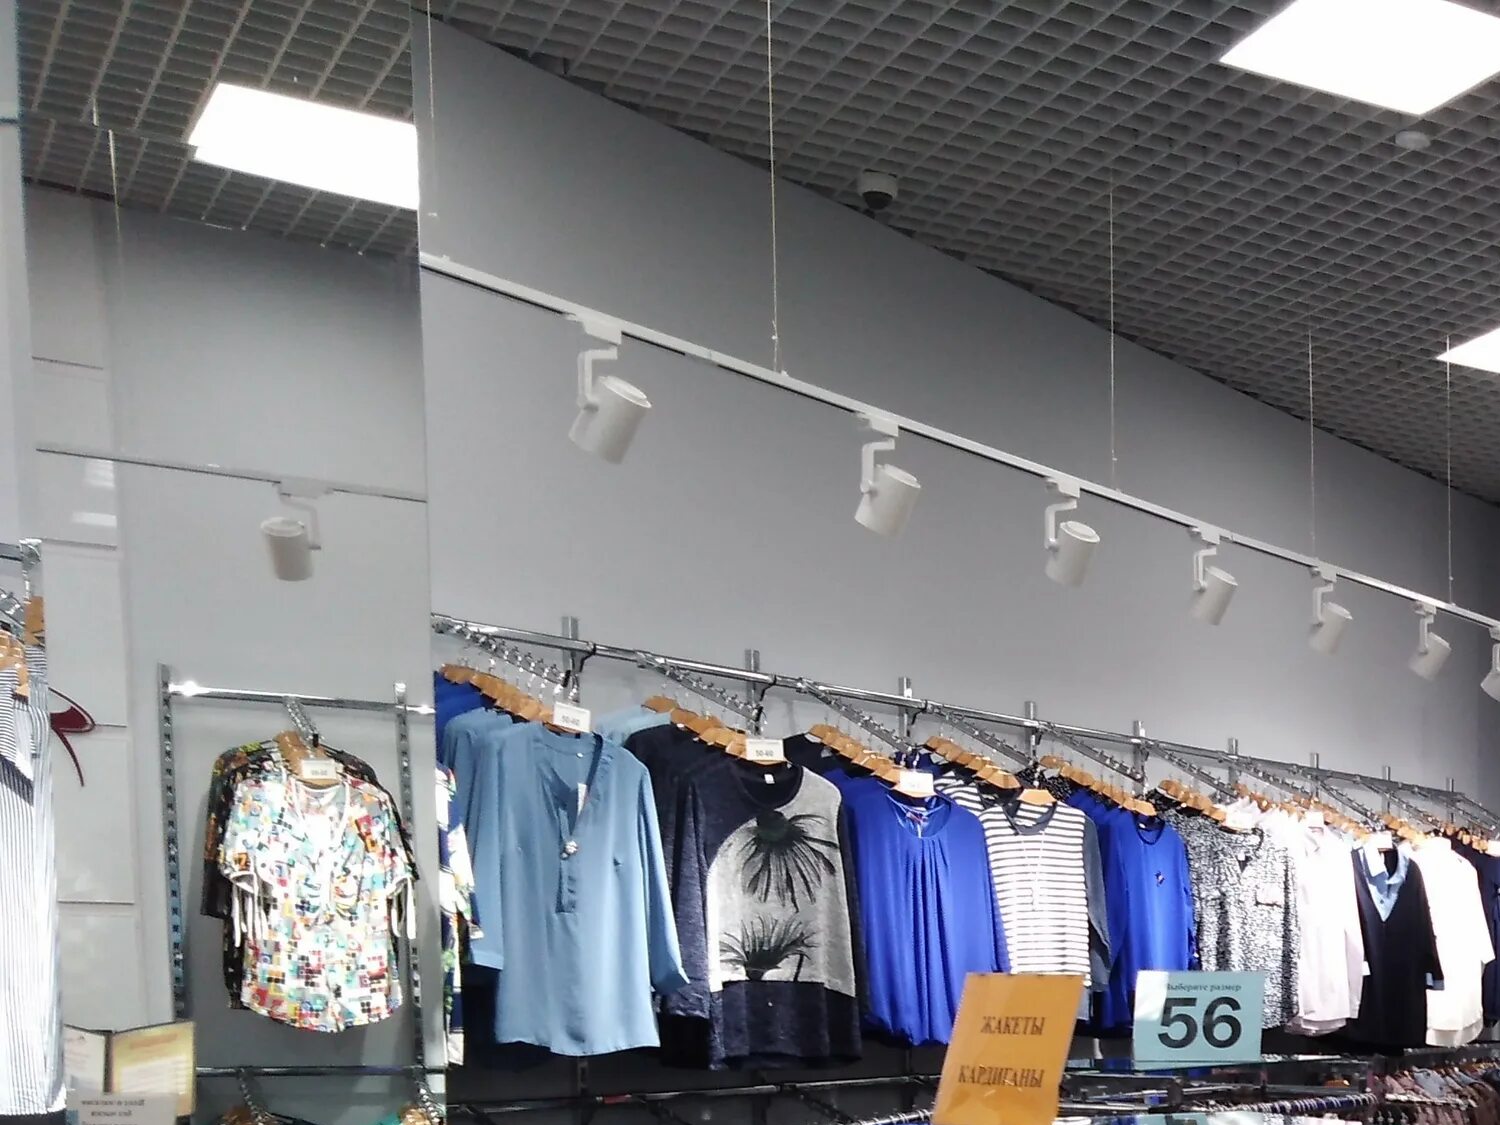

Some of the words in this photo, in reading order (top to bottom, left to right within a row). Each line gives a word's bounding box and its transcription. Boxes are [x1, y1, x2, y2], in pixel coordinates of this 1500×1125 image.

[1210, 985, 1242, 993] размер
[980, 1015, 1047, 1036] ЖАКЕТЫ
[1158, 997, 1242, 1049] 56
[958, 1064, 1046, 1088] КАРДИГАНЫ
